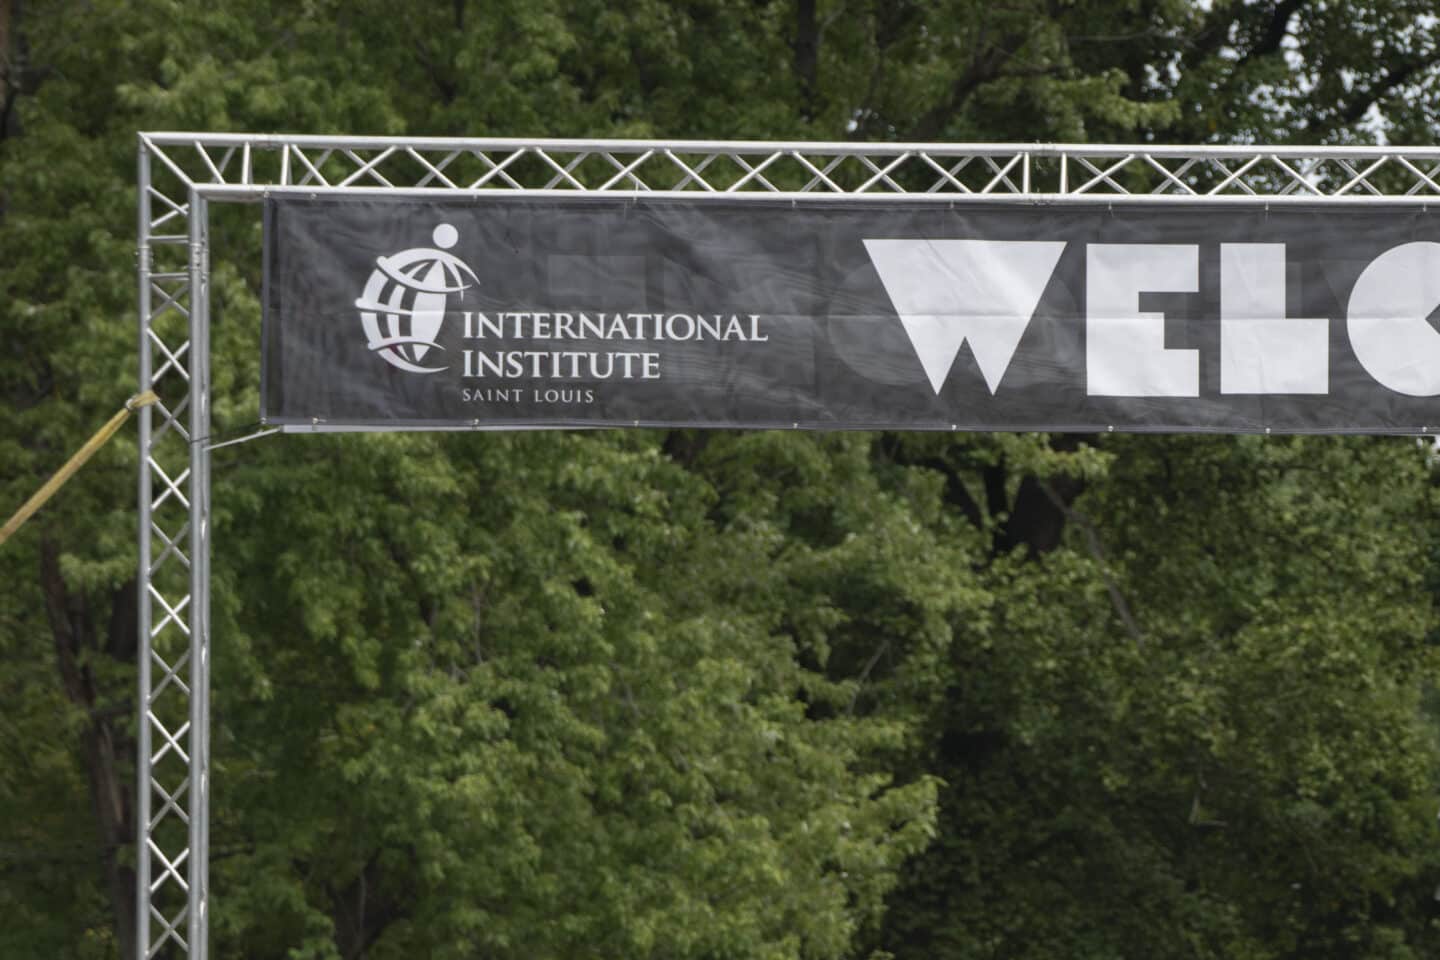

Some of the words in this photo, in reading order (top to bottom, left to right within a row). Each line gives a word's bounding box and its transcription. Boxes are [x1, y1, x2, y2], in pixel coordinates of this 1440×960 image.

[461, 310, 770, 342] INTERNATIONAL
[461, 349, 662, 379] INSTITUTE
[461, 388, 524, 404] SAINT
[533, 388, 595, 404] LOUIS
